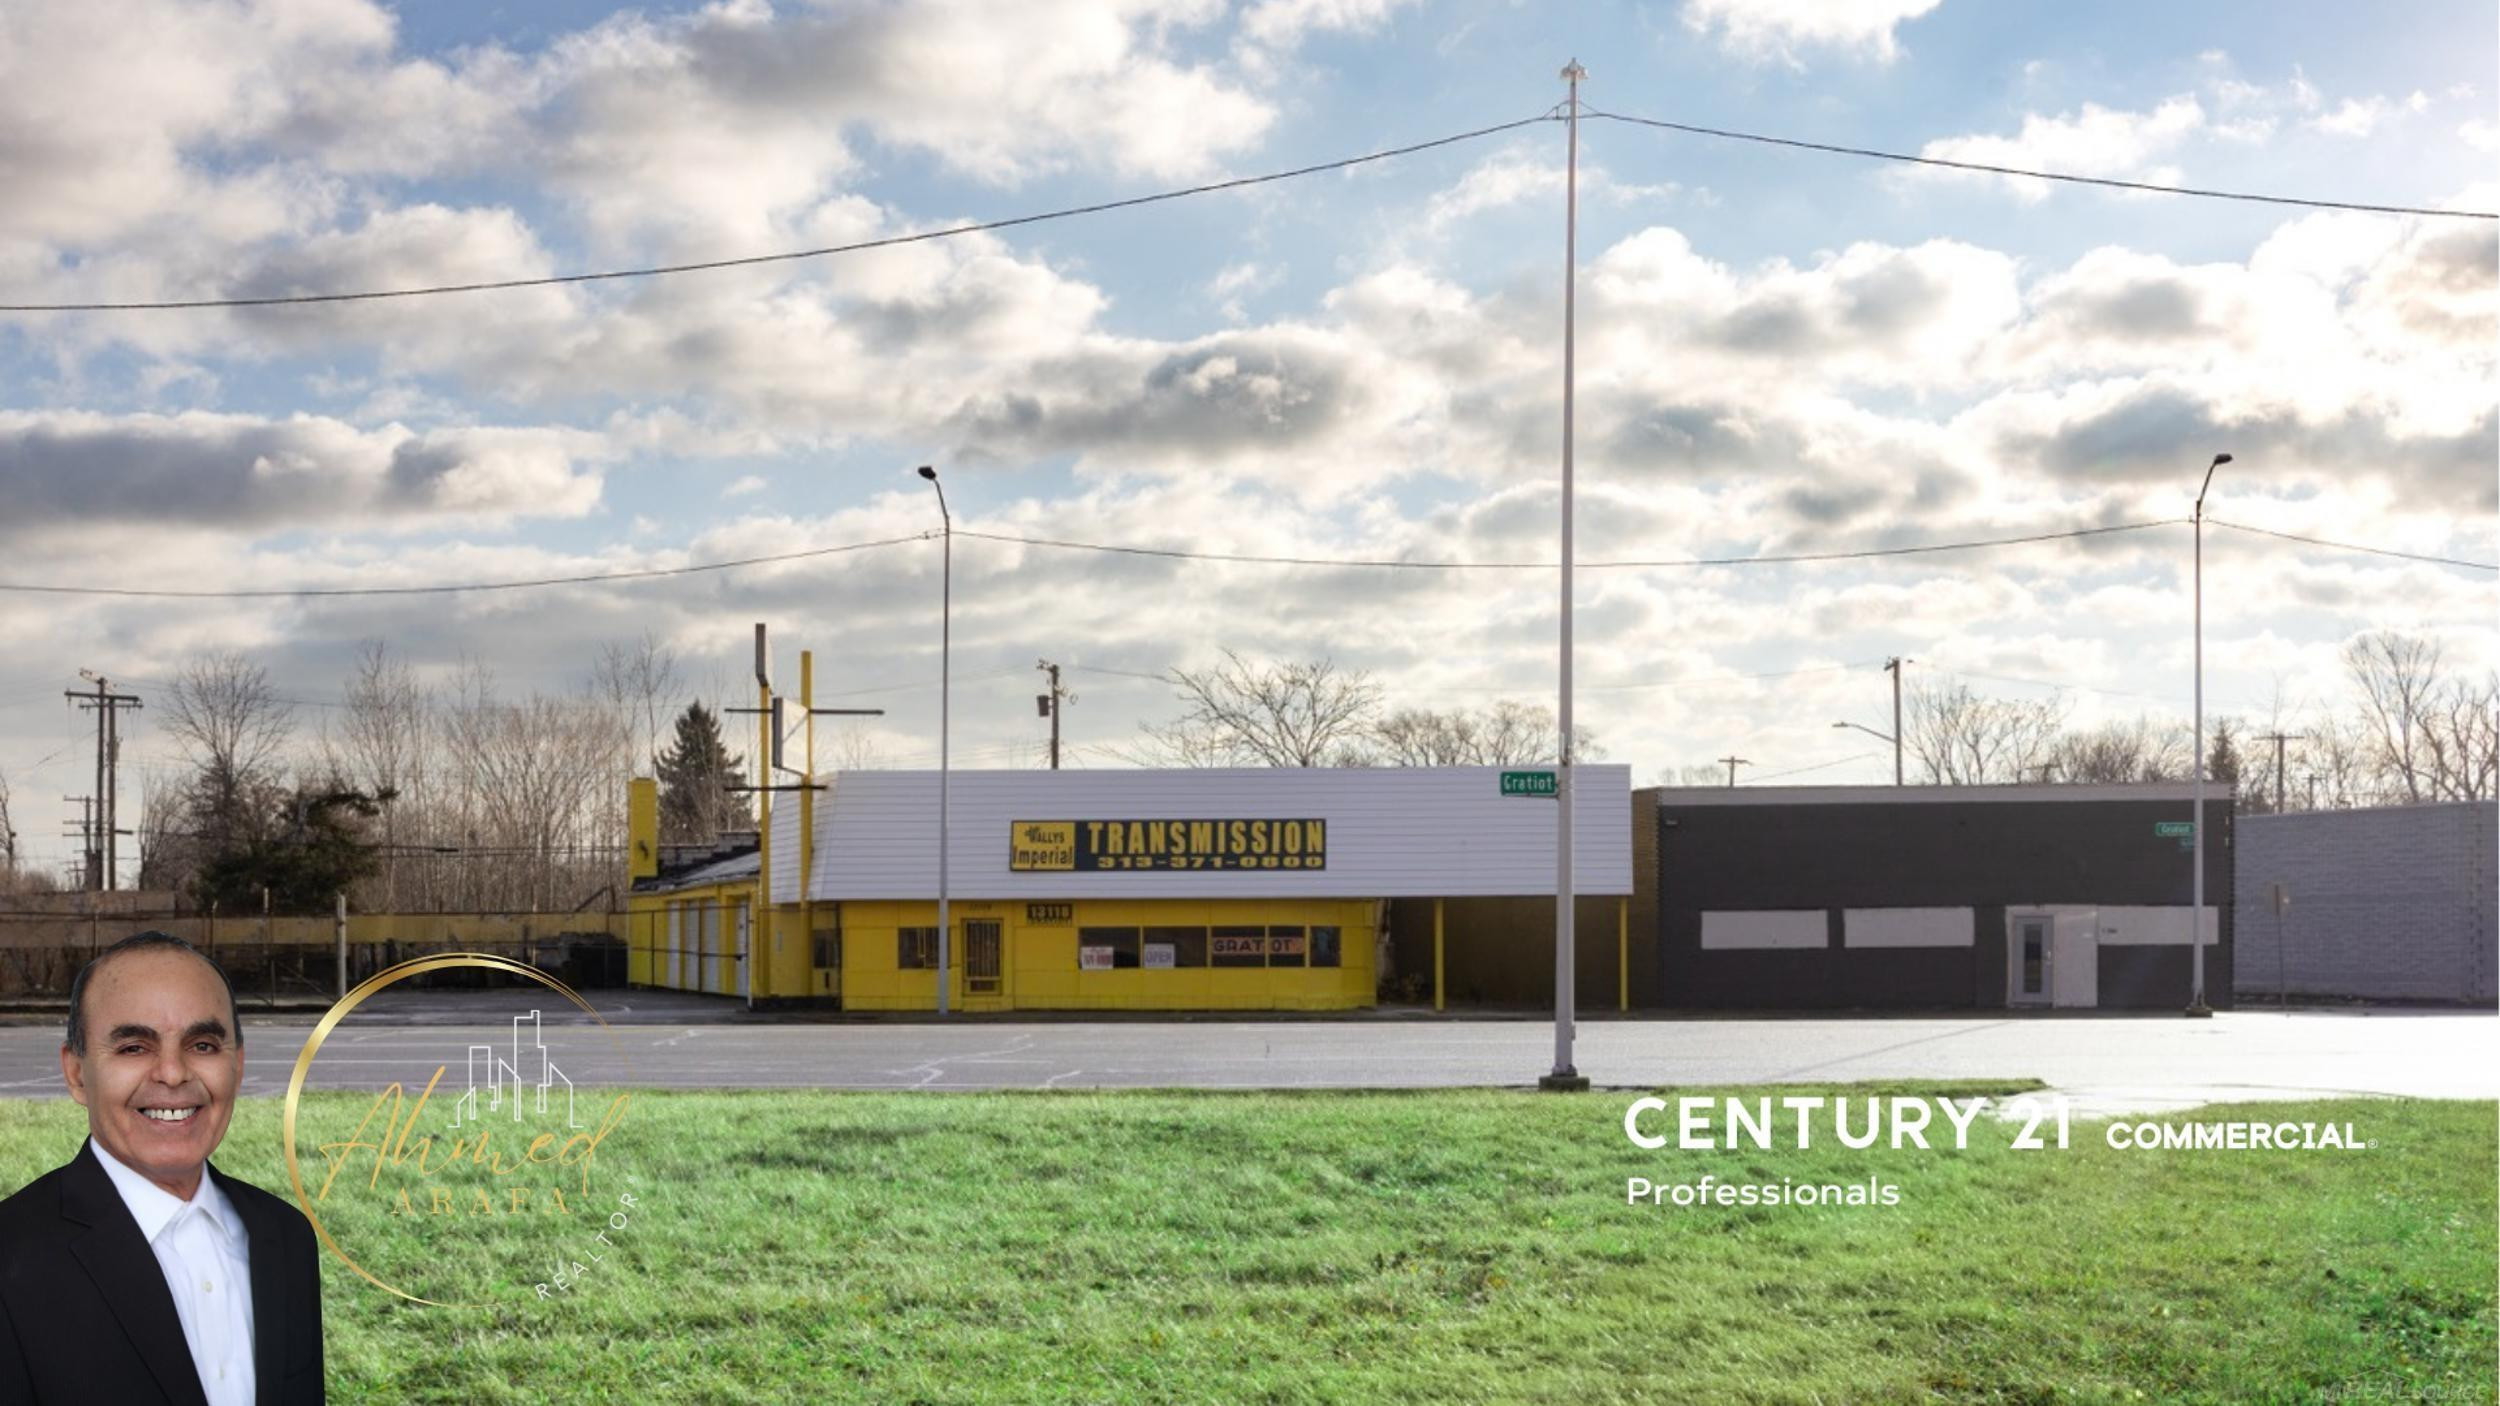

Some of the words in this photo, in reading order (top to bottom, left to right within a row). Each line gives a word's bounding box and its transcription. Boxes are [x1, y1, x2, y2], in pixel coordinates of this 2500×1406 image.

[1503, 775, 1553, 791] Gratiot
[1087, 820, 1324, 855] TRANSMISSION
[1013, 845, 1073, 869] Imperial
[1213, 939, 1292, 953] GRATOT
